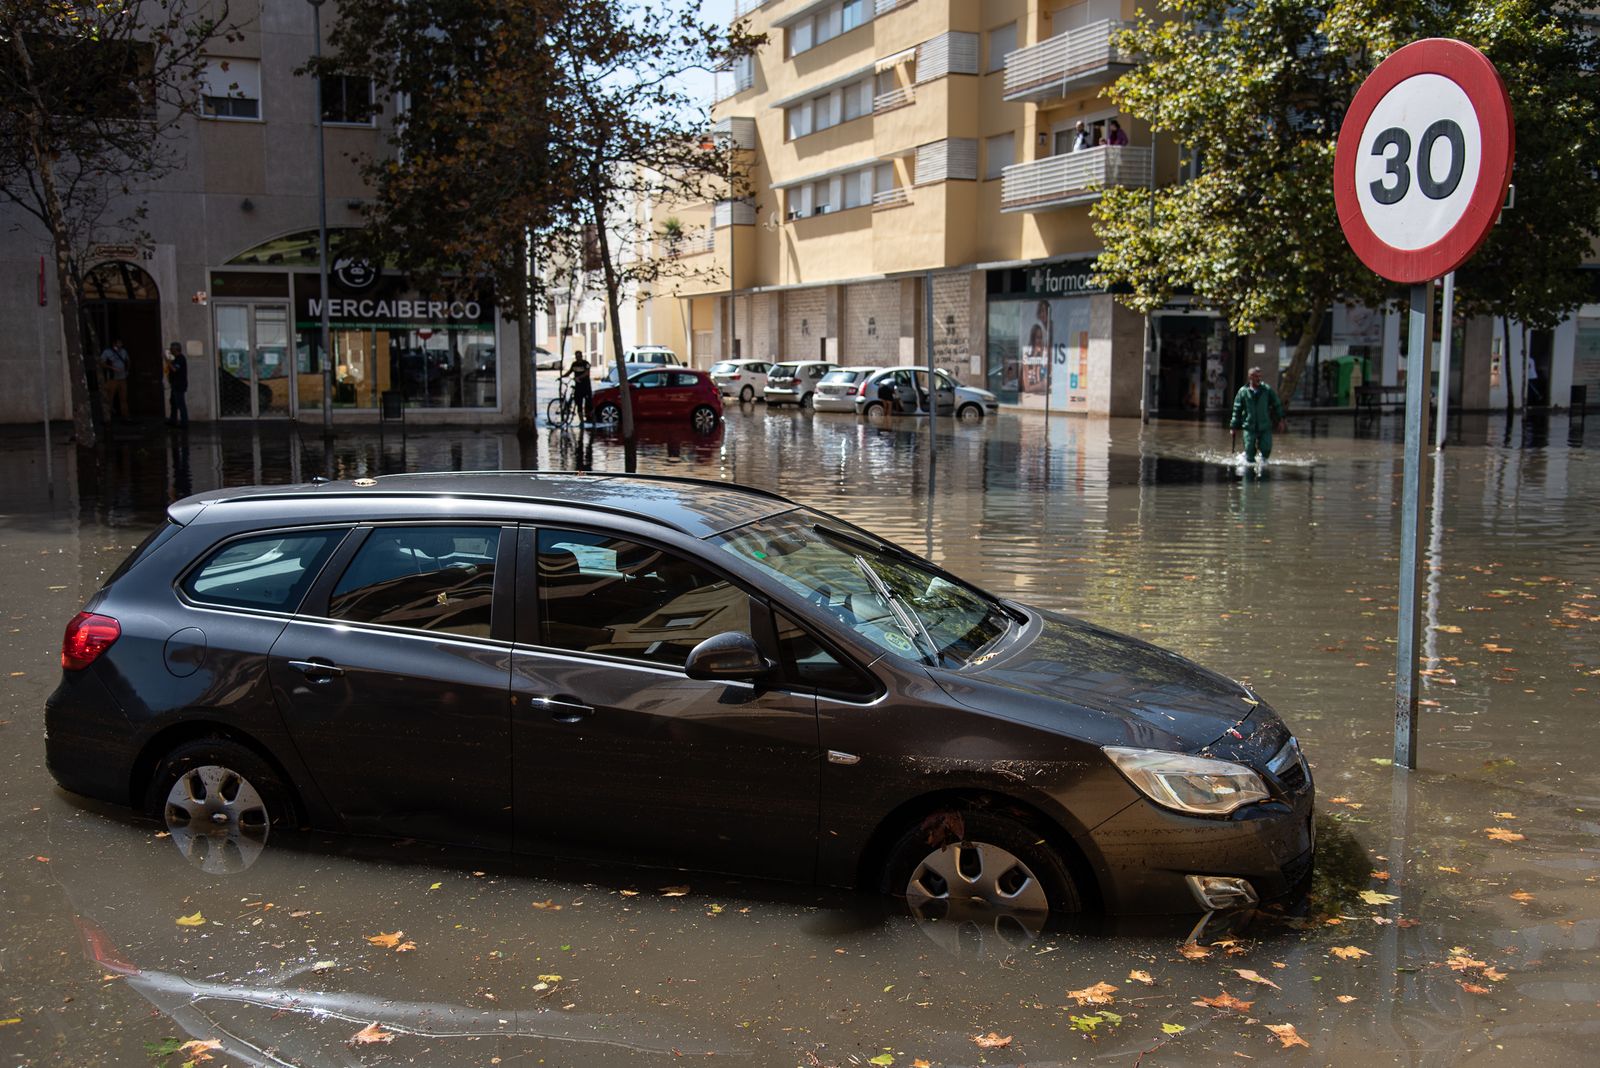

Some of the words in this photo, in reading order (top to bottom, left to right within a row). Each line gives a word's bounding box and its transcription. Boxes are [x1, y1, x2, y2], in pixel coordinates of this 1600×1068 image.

[1369, 118, 1466, 206] 30
[1045, 268, 1106, 292] farmac
[308, 298, 481, 320] MERCAIBERICO
